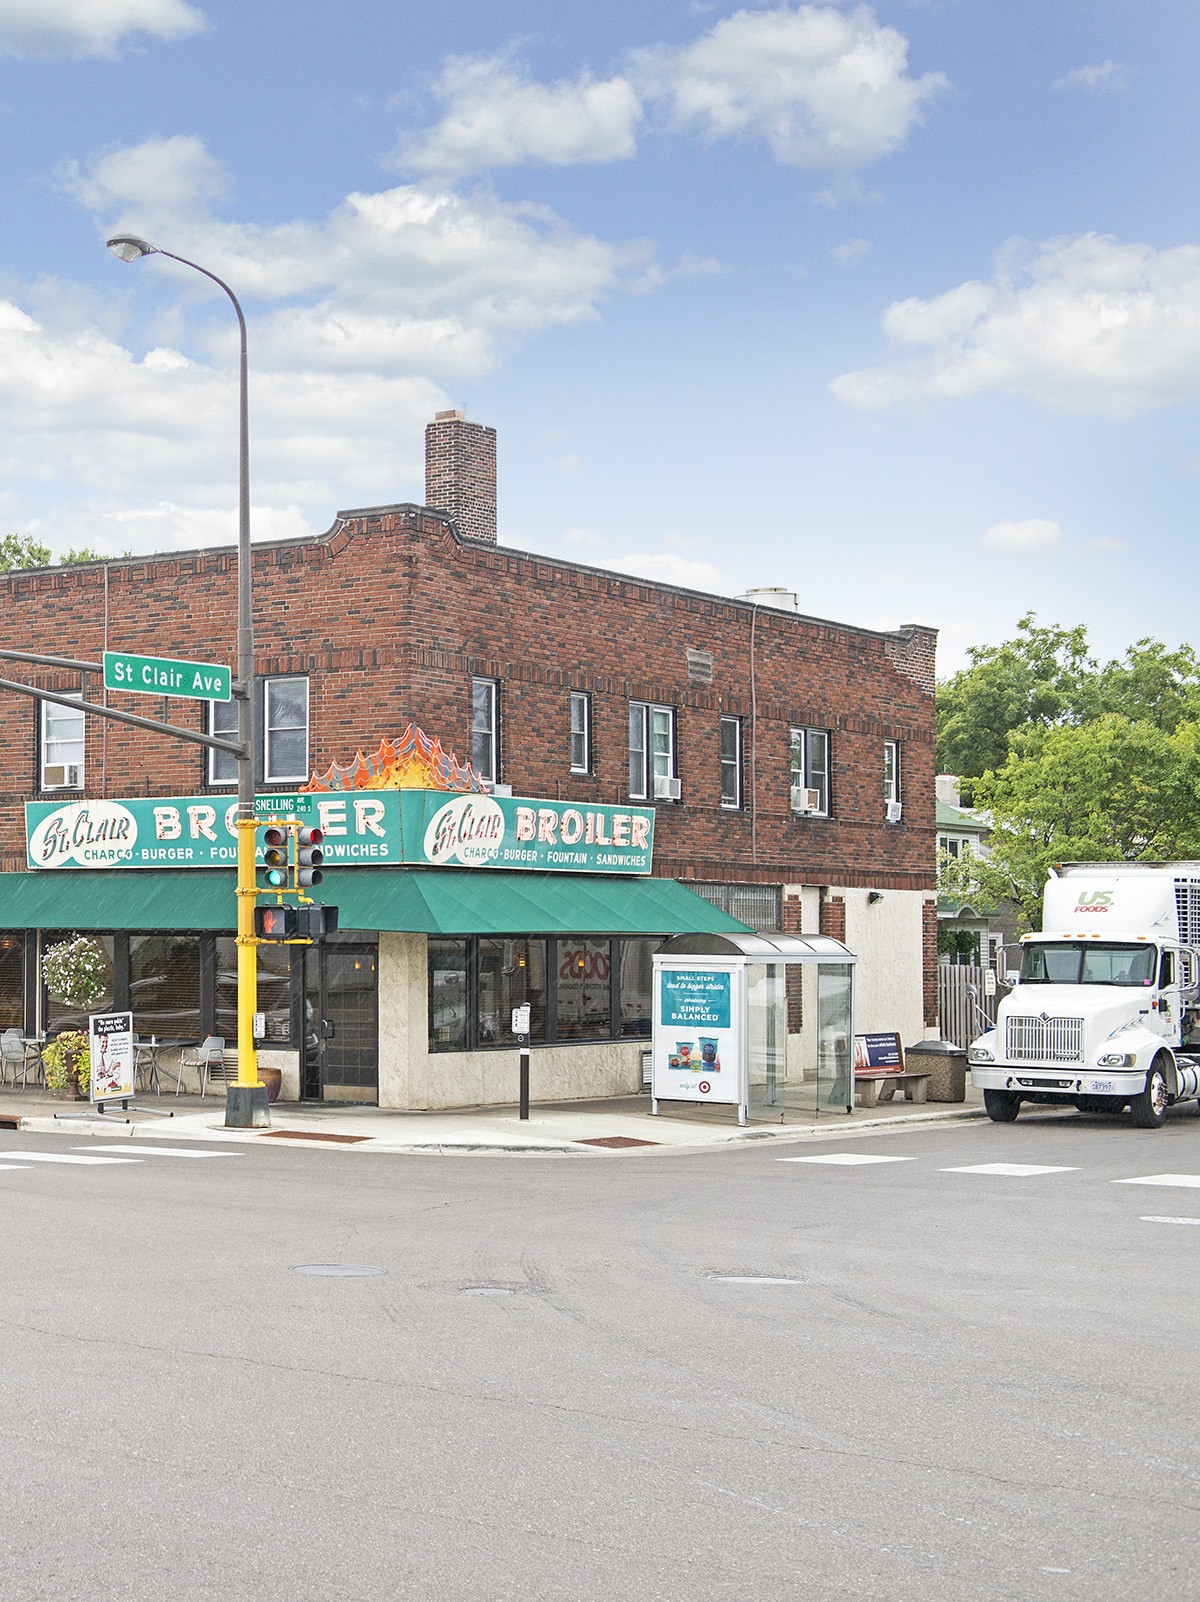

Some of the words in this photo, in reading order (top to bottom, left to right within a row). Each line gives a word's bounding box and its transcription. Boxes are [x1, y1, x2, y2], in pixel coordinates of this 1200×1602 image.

[114, 662, 133, 682] St
[142, 665, 183, 687] Clair
[192, 671, 222, 692] Ave
[255, 798, 294, 811] SNELLING
[296, 796, 305, 804] AVE
[515, 806, 651, 850] BROILER
[315, 843, 389, 857] NDWICHES
[547, 851, 588, 864] FOUNTAIN
[596, 853, 646, 867] SANDWICHES
[1074, 905, 1109, 913] FOODS
[680, 1005, 711, 1013] SIMPLY
[671, 1012, 719, 1021] BALANCED
